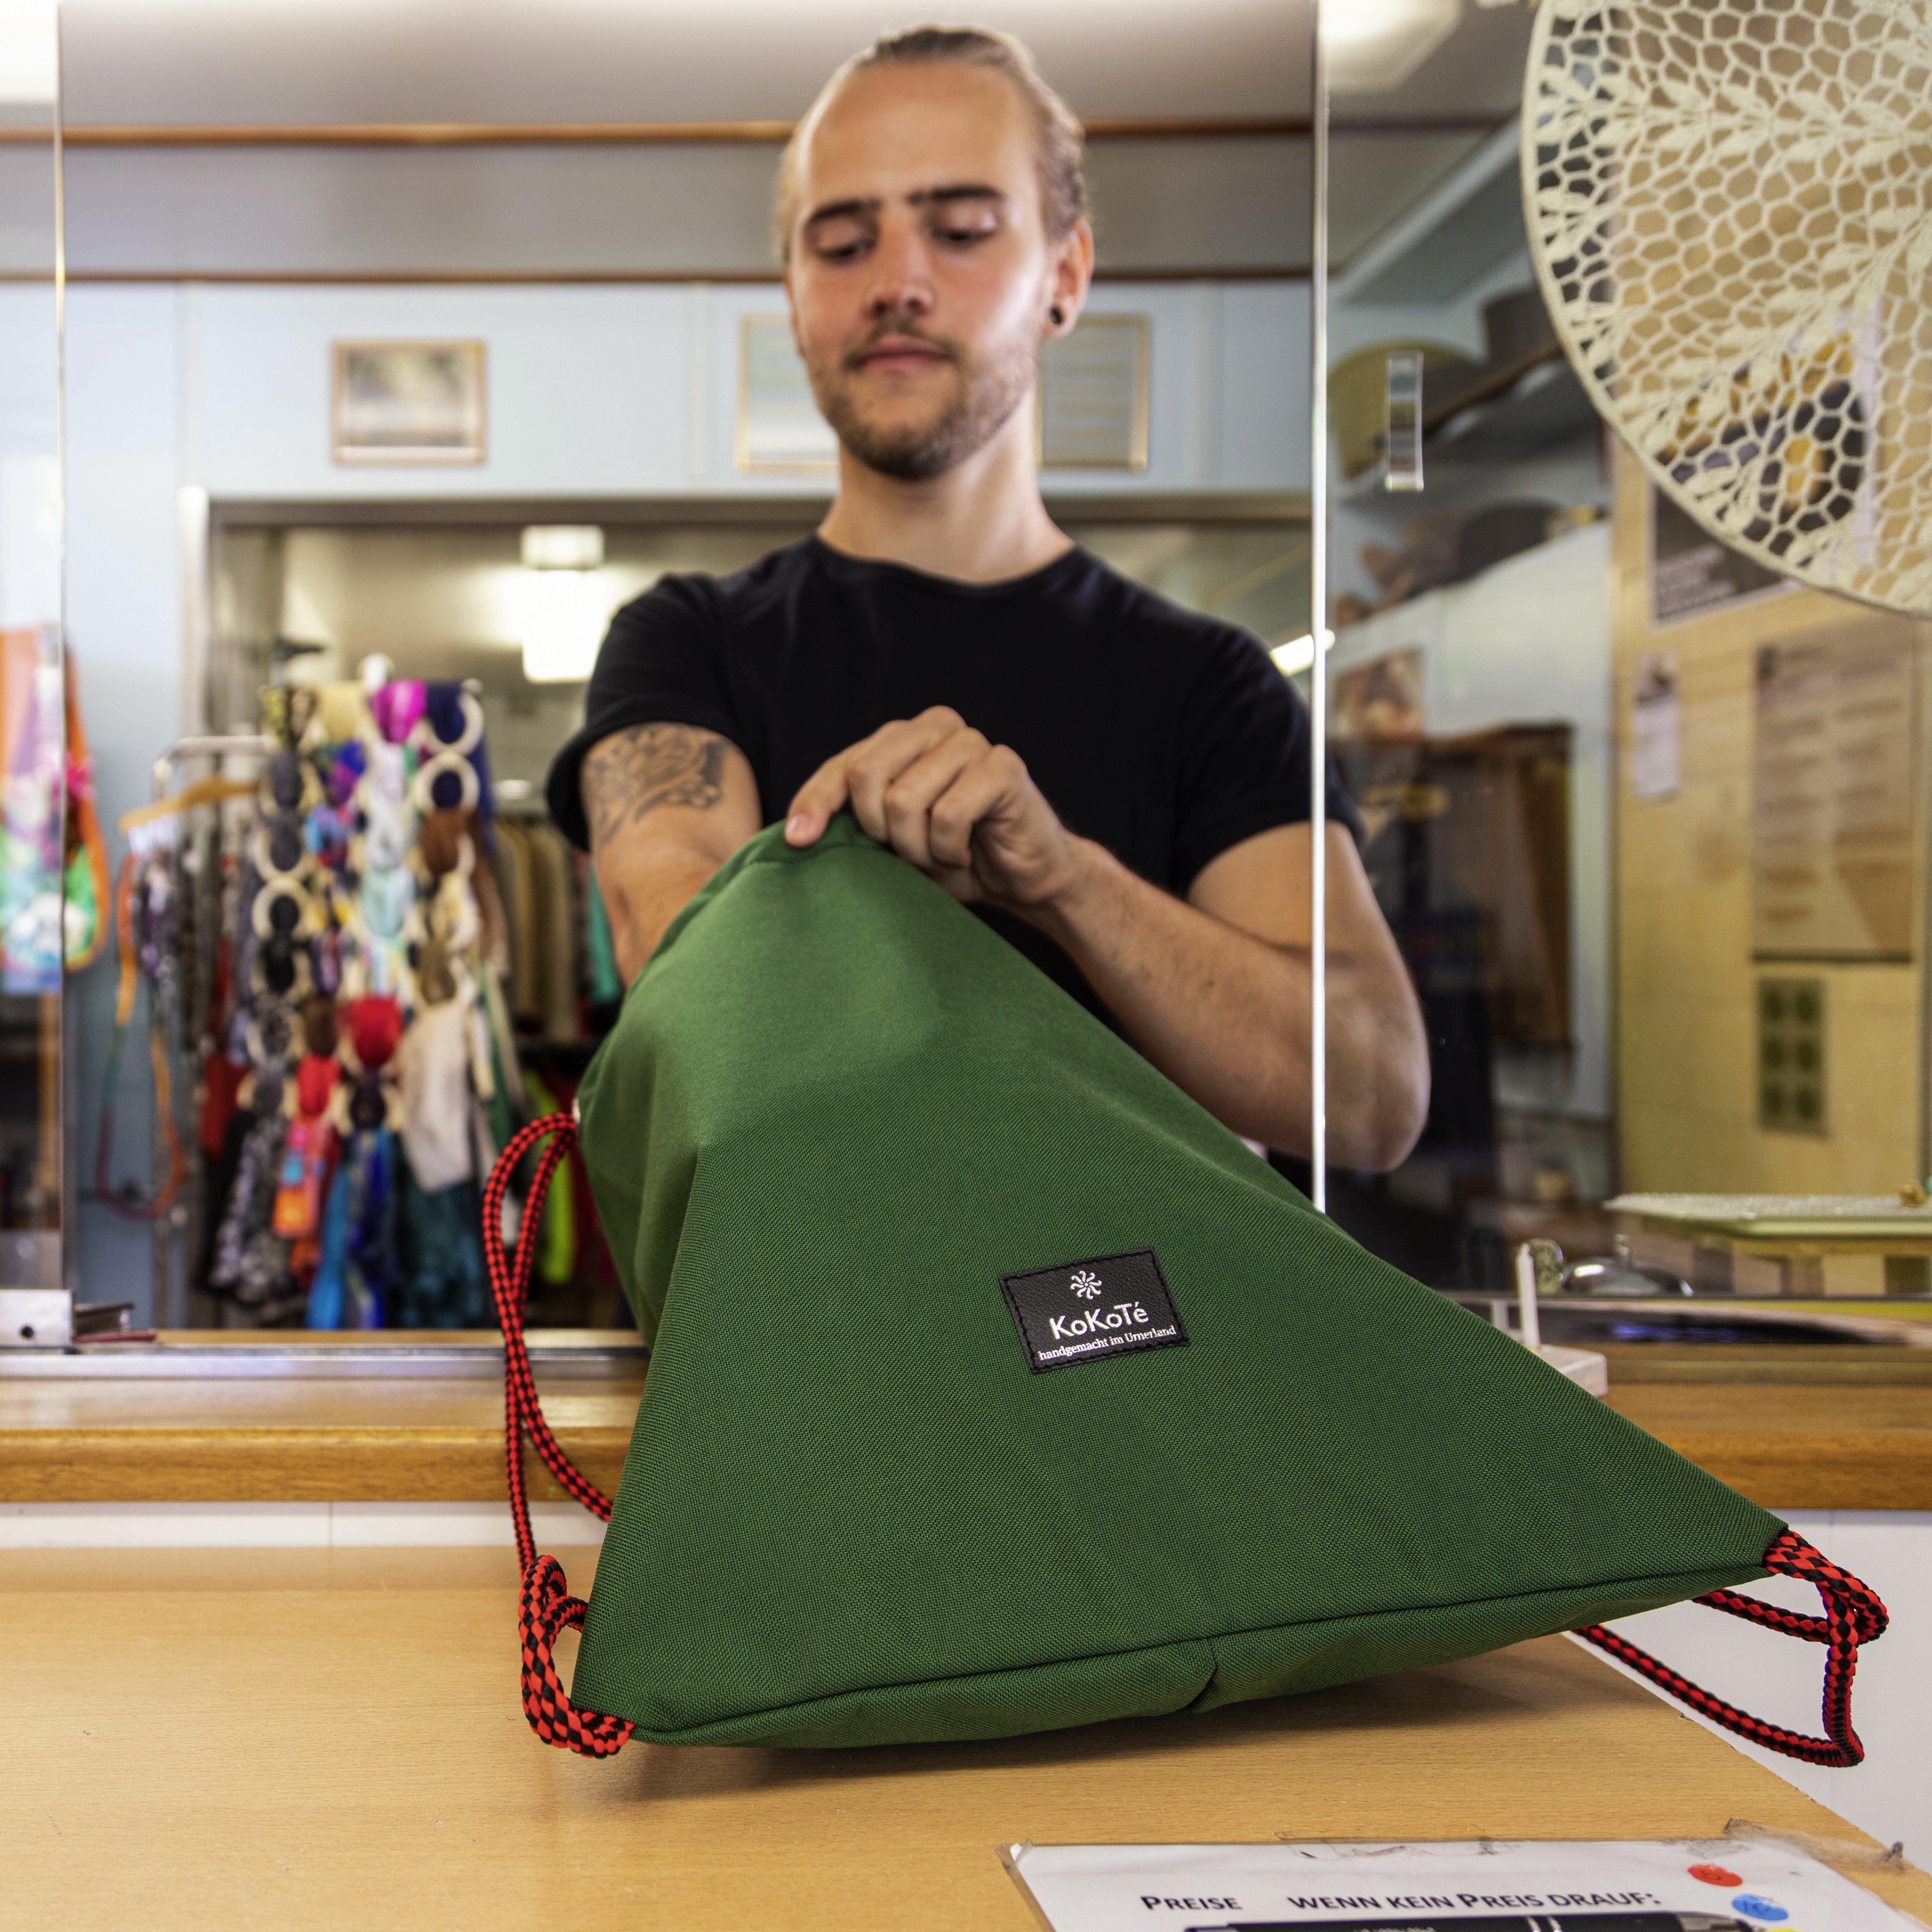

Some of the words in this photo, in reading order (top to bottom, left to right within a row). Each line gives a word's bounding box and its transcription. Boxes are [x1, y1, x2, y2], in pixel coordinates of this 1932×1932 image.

[1049, 1302, 1149, 1340] KoKoTé
[1038, 1338, 1109, 1360] handgemacht
[1109, 1336, 1124, 1346] im
[1124, 1325, 1177, 1343] Urnerland
[1140, 1896, 1243, 1910] PREISE
[1286, 1896, 1383, 1909] WENN
[1386, 1896, 1456, 1908] KEIN
[1456, 1893, 1545, 1908] PREIS
[1546, 1891, 1661, 1906] DRAUF:
